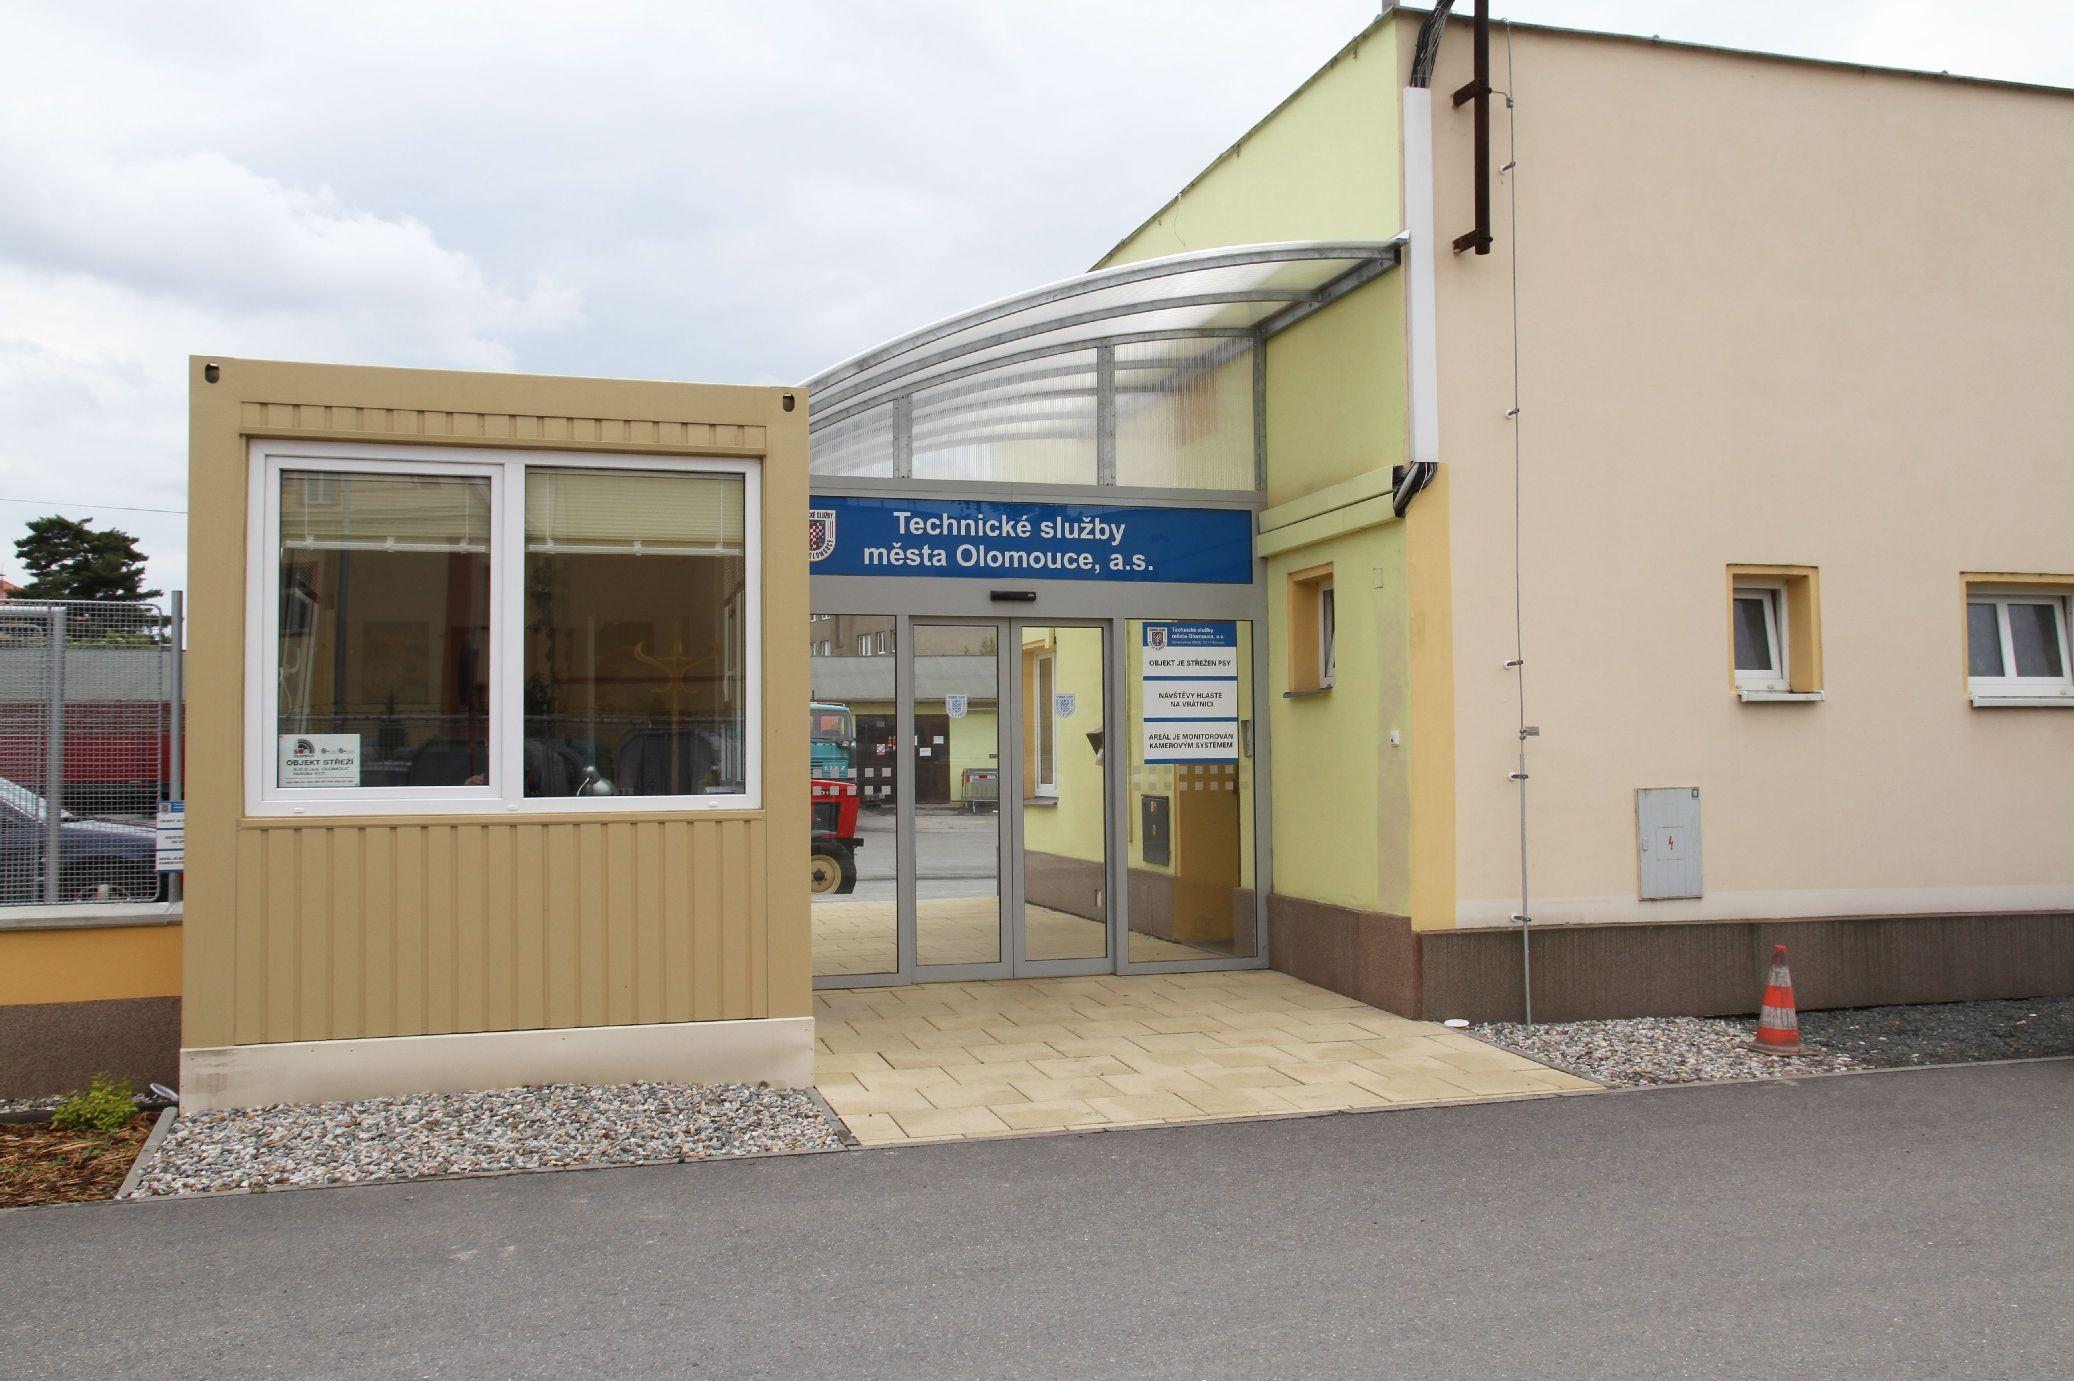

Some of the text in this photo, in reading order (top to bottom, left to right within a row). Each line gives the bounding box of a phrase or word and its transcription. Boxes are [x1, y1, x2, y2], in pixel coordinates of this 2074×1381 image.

[893, 511, 1126, 546] Technické služby
[863, 541, 1154, 573] města Olomouce, a.s.
[1148, 657, 1231, 667] OBJEKT JE STŘEŽEN PSY
[1158, 691, 1195, 699] NÁVŠTĚVY
[1182, 698, 1214, 707] VRÁTNICI
[1148, 732, 1171, 740] AREÁL
[1182, 732, 1234, 740] MONITOROVÁN
[1149, 740, 1233, 749] KAMEROVÝM SYSTÉMEM
[323, 757, 354, 766] STŘEŽÍ
